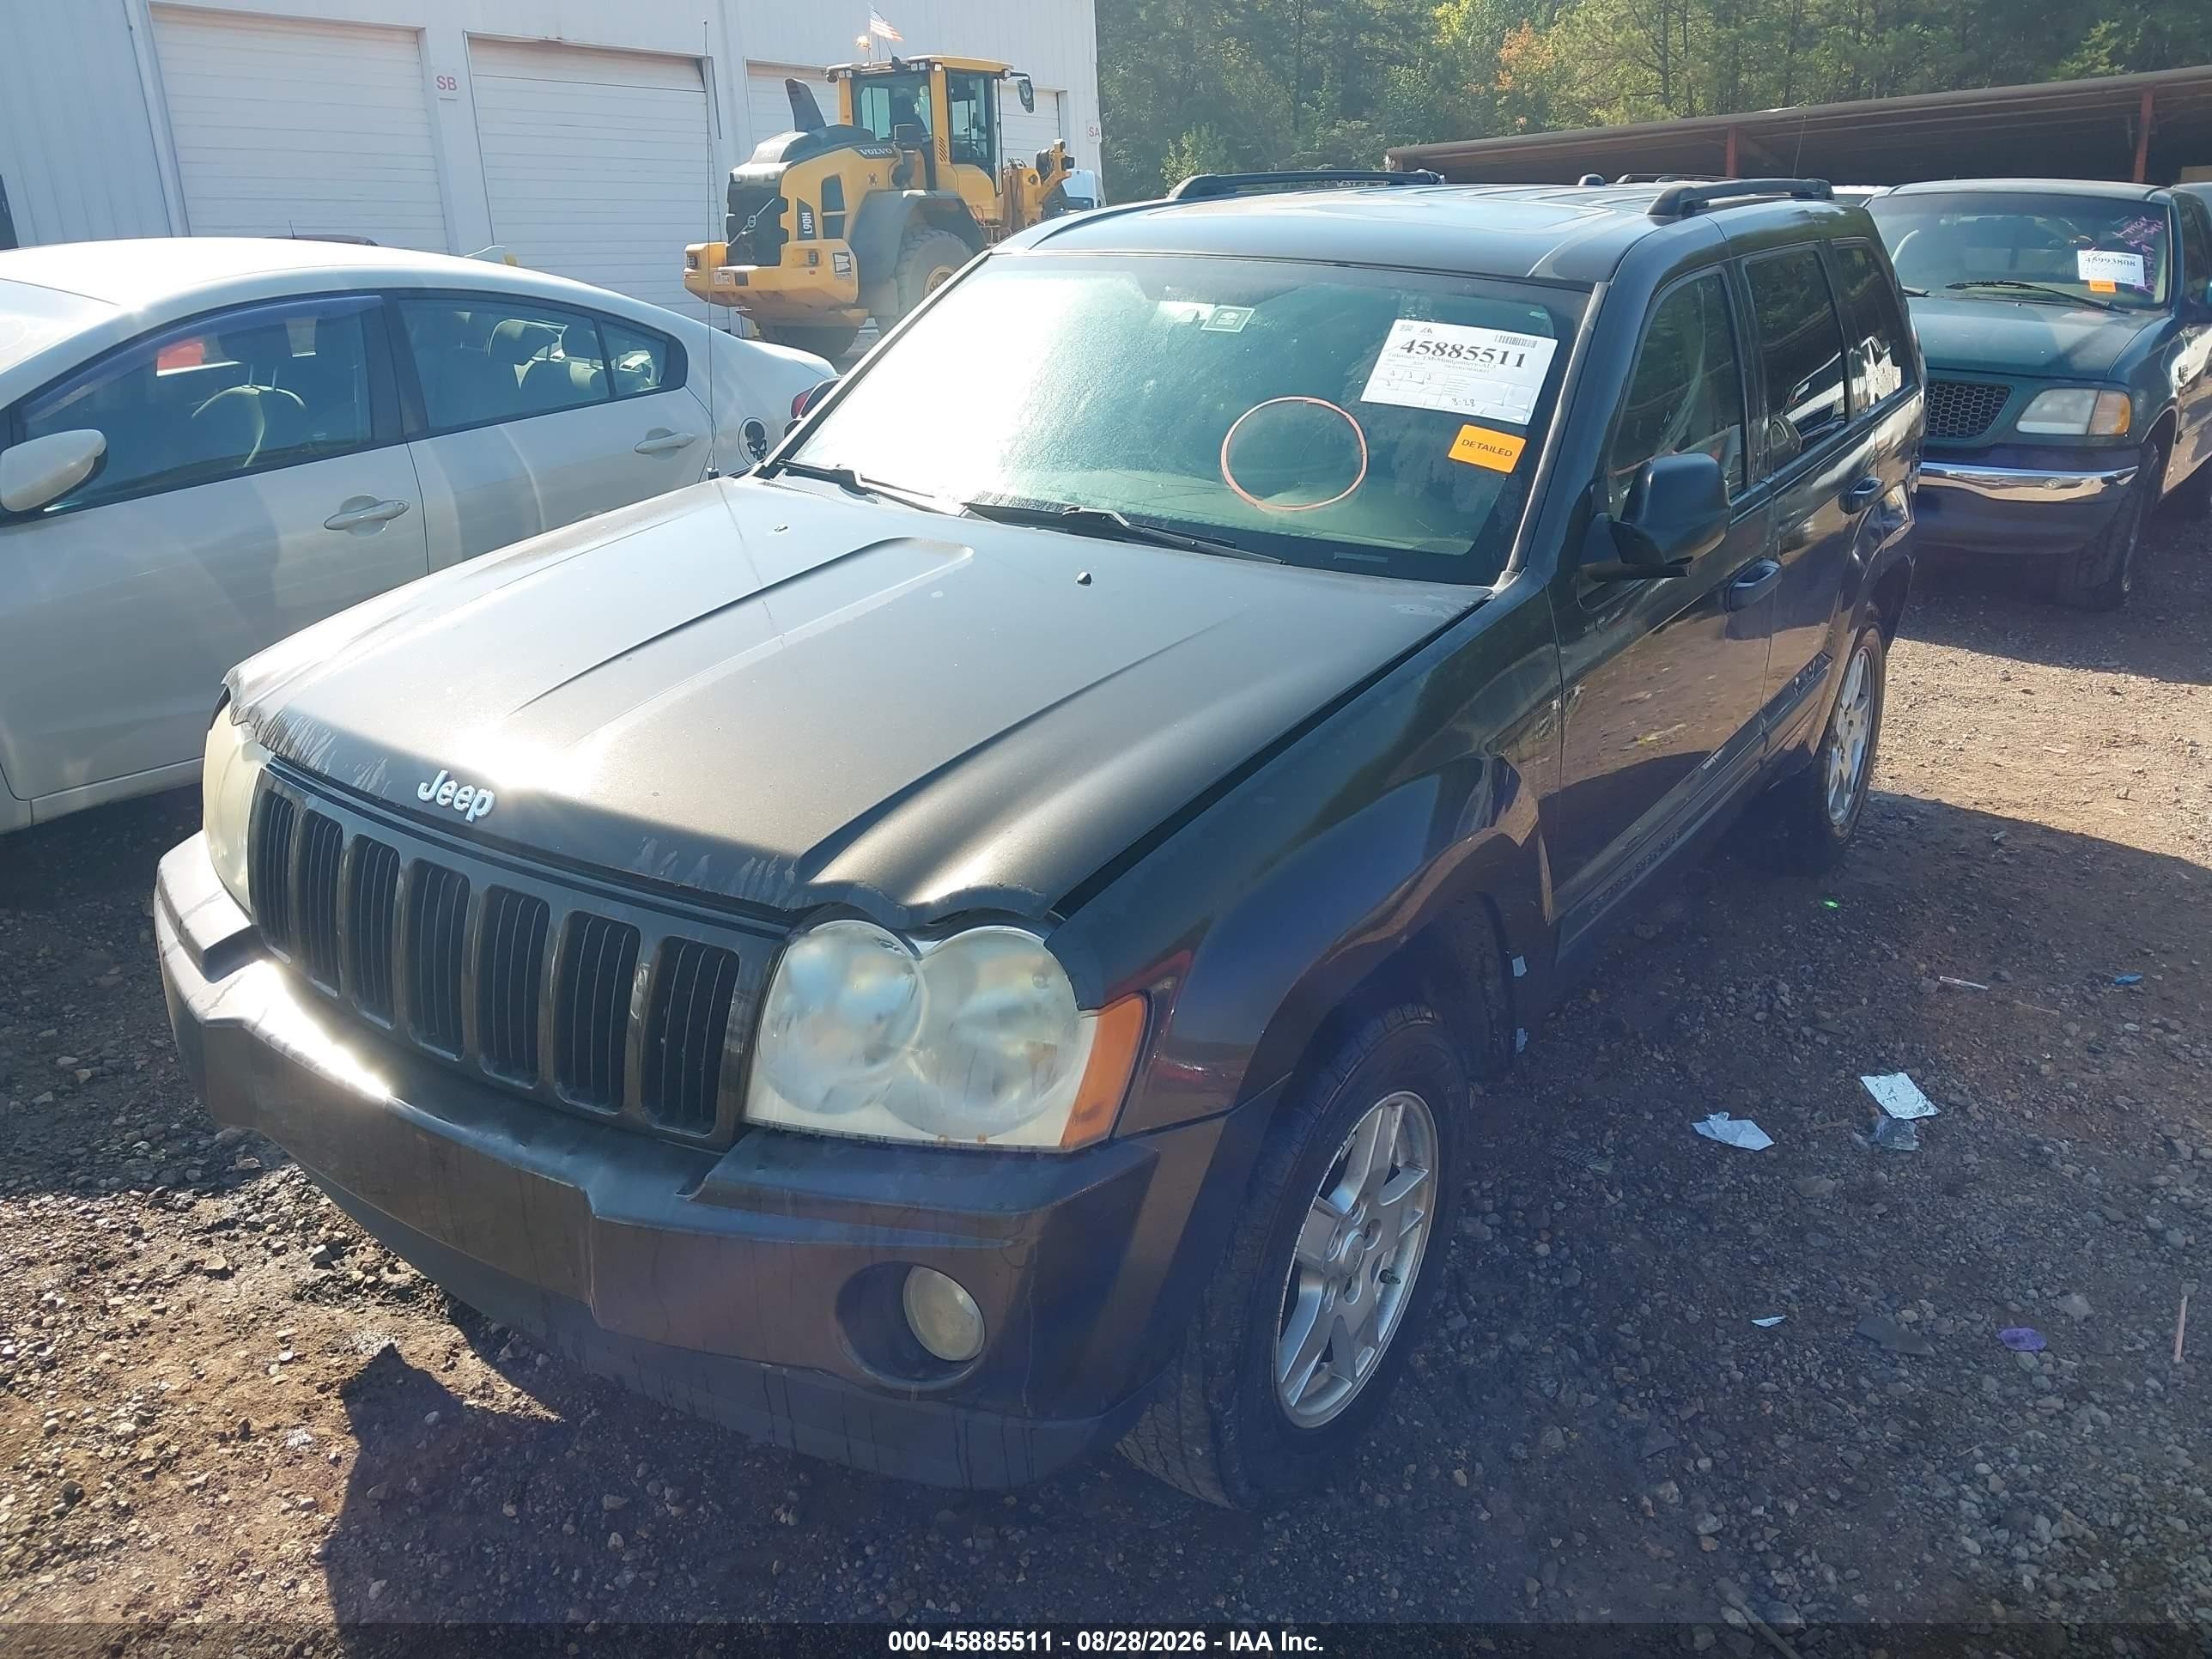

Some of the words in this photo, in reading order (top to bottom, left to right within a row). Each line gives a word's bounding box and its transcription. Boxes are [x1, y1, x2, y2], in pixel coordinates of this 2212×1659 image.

[436, 75, 458, 91] SB
[1088, 126, 1100, 137] SA
[801, 212, 813, 234] L90H
[1400, 338, 1526, 368] 45885511
[1462, 439, 1513, 457] DETAILED
[417, 769, 495, 823] Jeep
